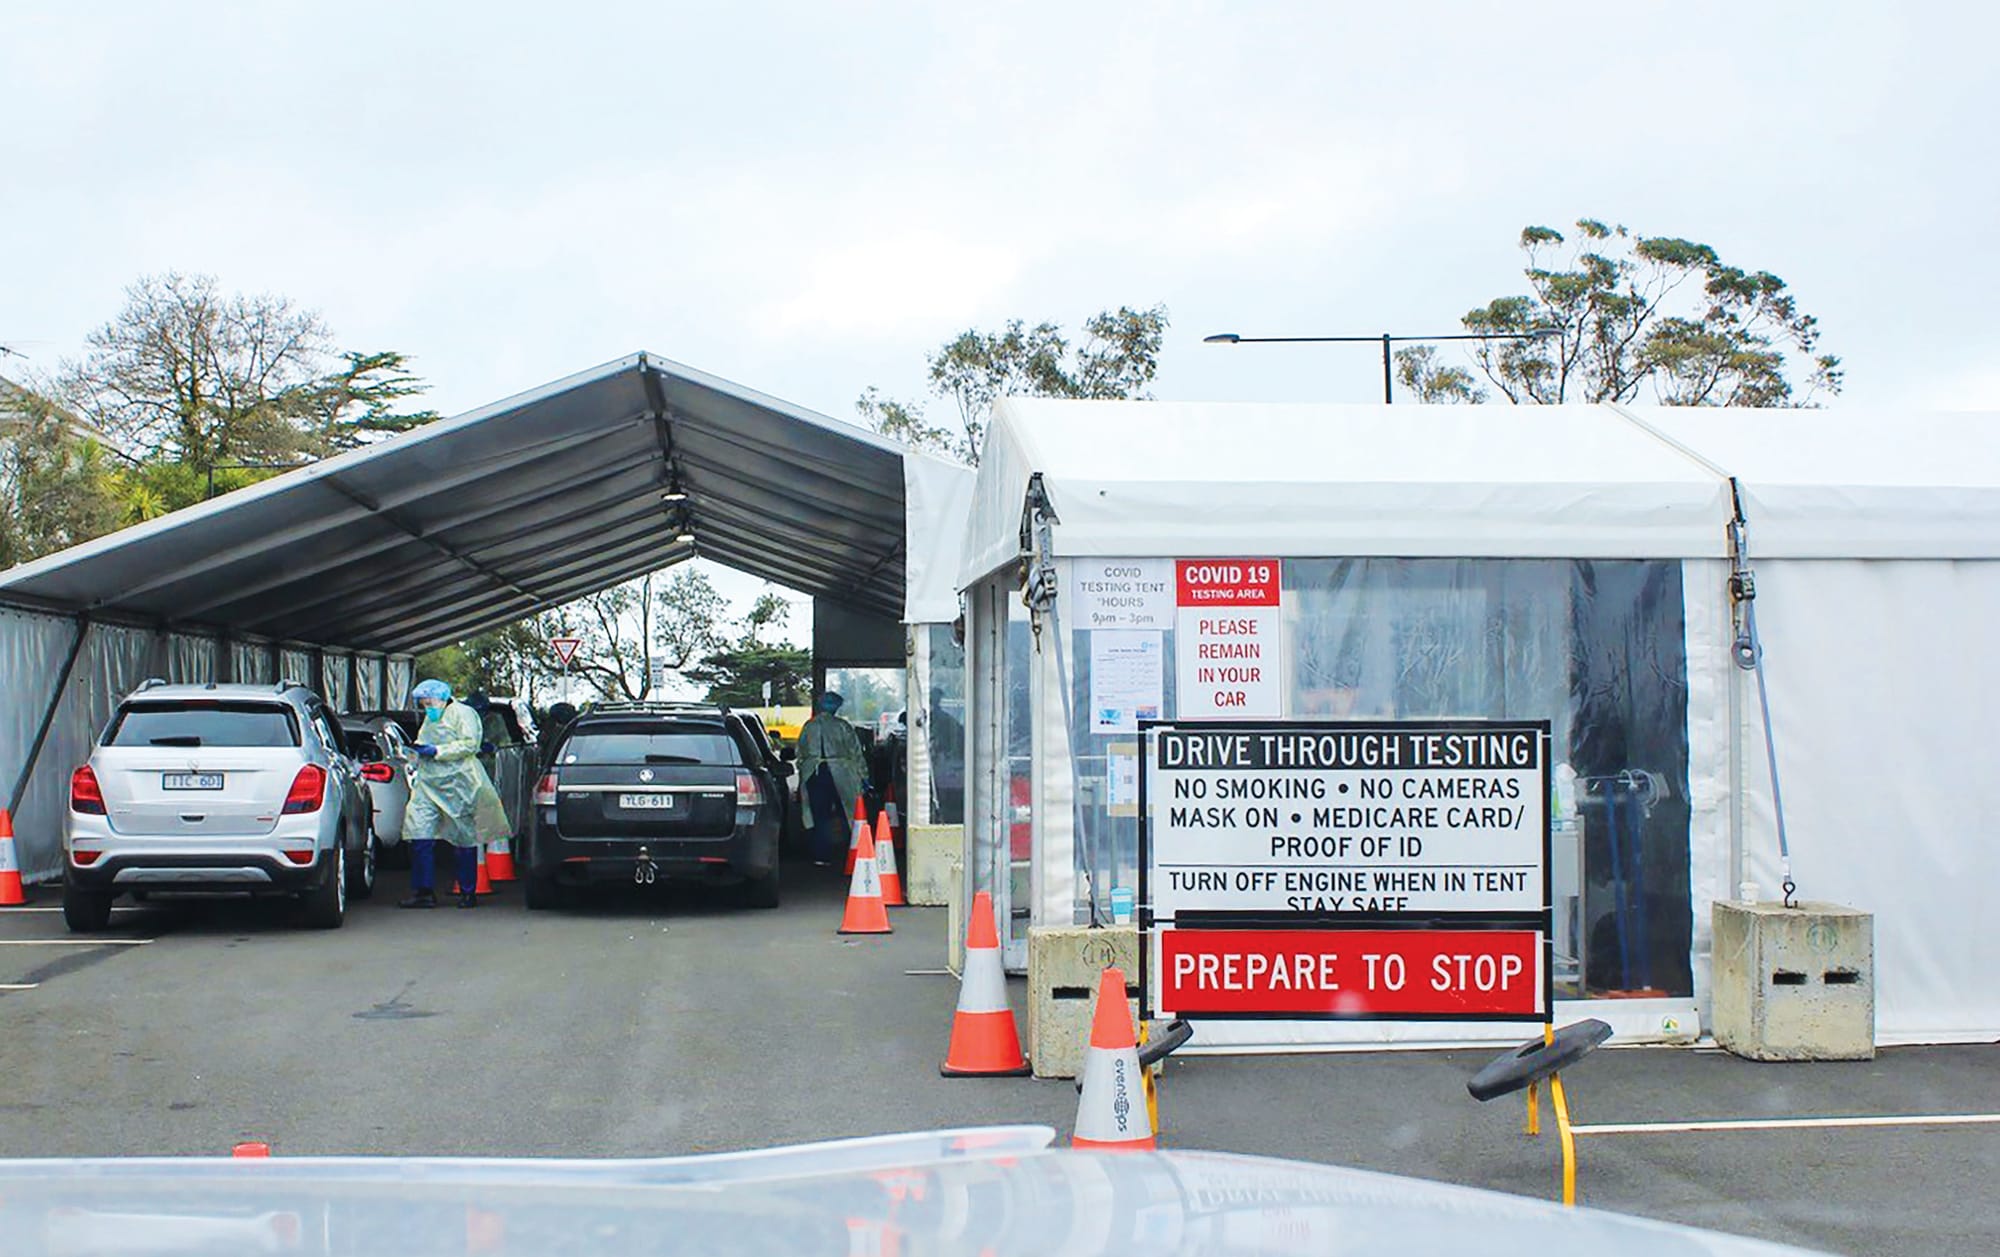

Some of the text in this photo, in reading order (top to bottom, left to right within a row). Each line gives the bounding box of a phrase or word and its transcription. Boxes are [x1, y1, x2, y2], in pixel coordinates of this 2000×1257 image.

[1104, 567, 1142, 578] COVID
[1186, 566, 1270, 585] COVID 19
[1080, 582, 1165, 593] TESTING TENT
[1191, 589, 1266, 600] TESTING AREA
[1199, 619, 1258, 635] PLEASE
[1199, 643, 1261, 660] REMAIN
[1198, 667, 1261, 684] IN YOUR
[1214, 691, 1246, 708] CAR
[1166, 735, 1529, 766] DRIVE THROUGH TESTING
[1174, 778, 1520, 800] NO SMOKING NO CAMERAS
[1170, 804, 1525, 830] MASK ON MEDICARE CARD/
[1271, 836, 1422, 858] PROOF OF ID
[1169, 871, 1528, 892] TURN OFF ENGINE WHEN IN TENT
[1287, 896, 1409, 911] STAY SAFE
[1174, 953, 1522, 992] PREPARE TO STOP
